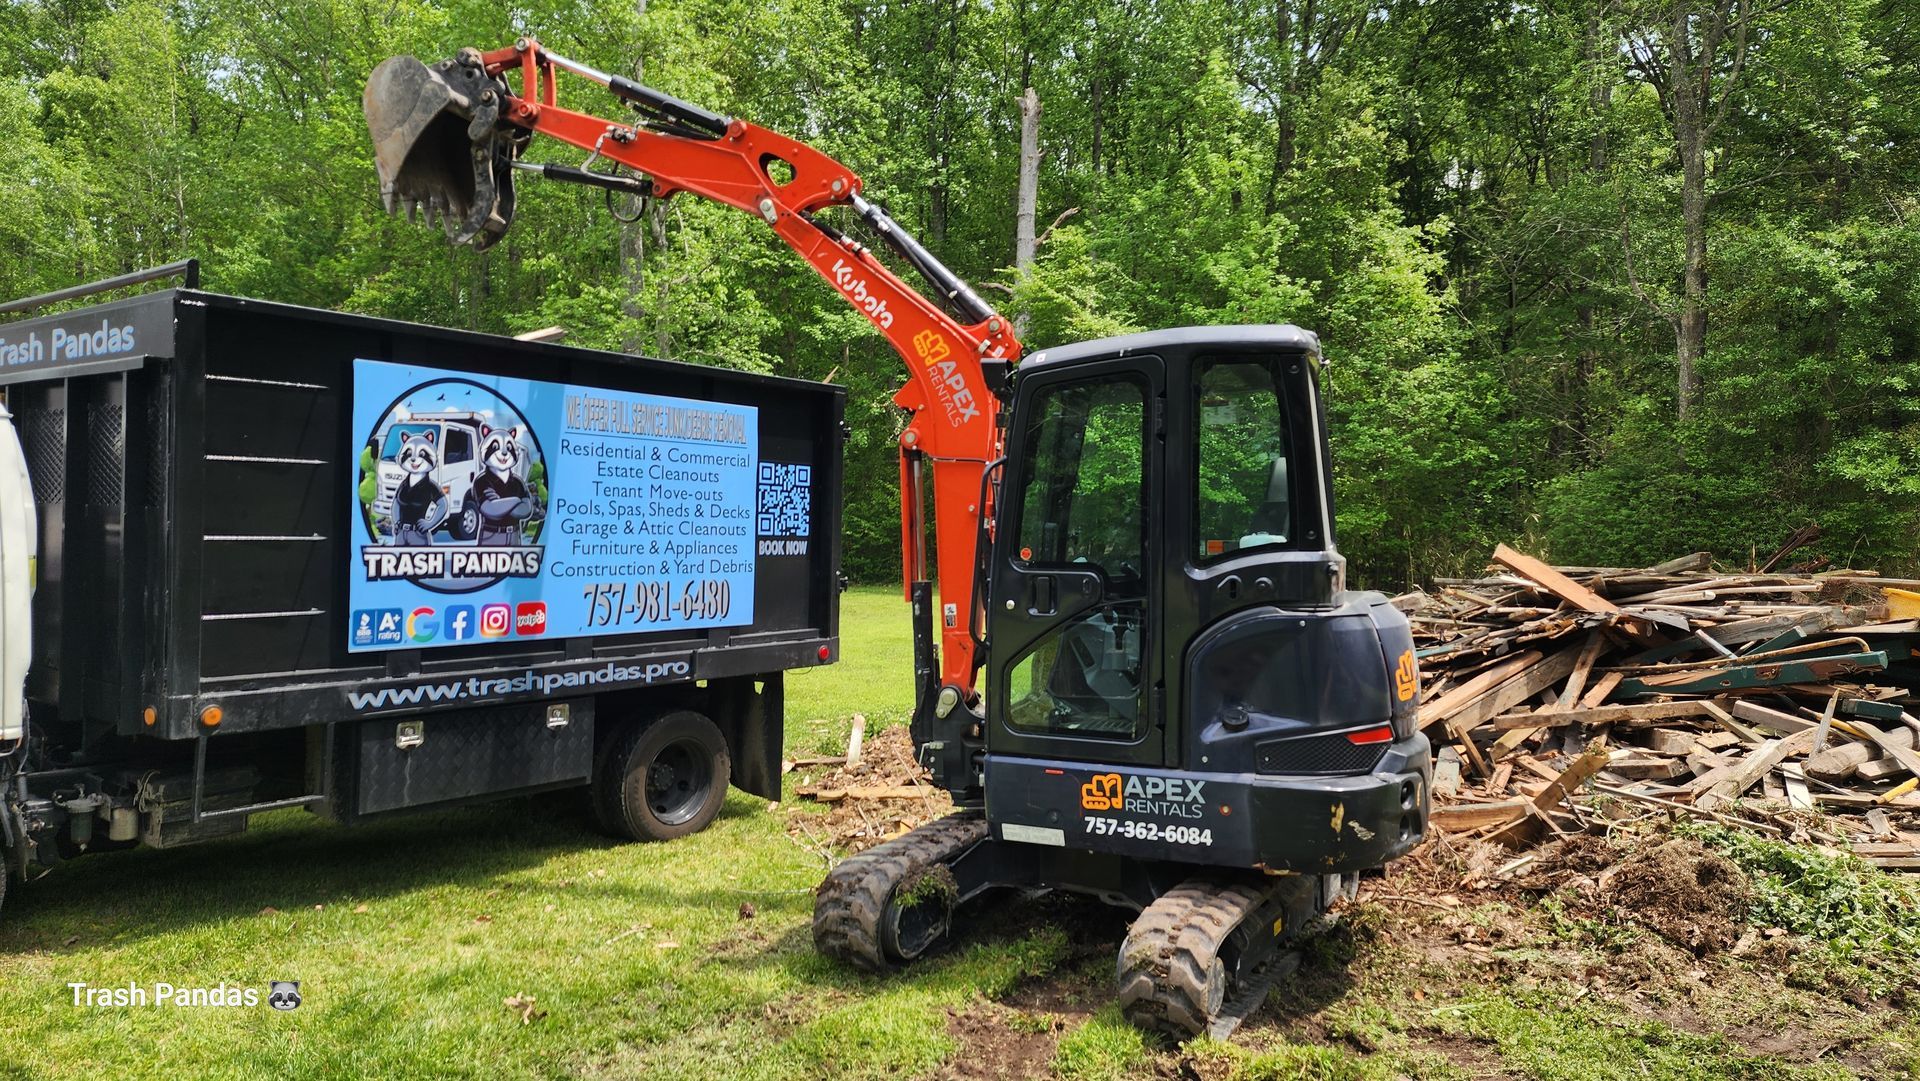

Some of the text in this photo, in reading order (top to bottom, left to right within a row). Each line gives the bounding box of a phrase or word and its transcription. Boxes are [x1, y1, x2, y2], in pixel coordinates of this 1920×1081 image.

[831, 258, 894, 330] Kubota
[0, 319, 135, 367] rash Pandas
[927, 365, 962, 429] RENTALS
[937, 360, 980, 424] APEX
[566, 395, 580, 430] WE
[583, 396, 609, 432] OFFER
[611, 399, 630, 434] FULL
[632, 402, 664, 437] SERVICE
[714, 411, 747, 444] REMOVAL
[561, 439, 750, 468] Residential & Commercial
[597, 461, 720, 483] Estate Cleanouts
[592, 481, 723, 501] Tenant Move-outs
[556, 499, 750, 520] Pools, Spas, Sheds & Decks
[561, 518, 747, 539] Garage & Attic Cleanouts
[572, 540, 738, 558] Furniture & Appliances
[758, 541, 808, 556] BOOK NOW
[363, 551, 540, 579] TRASH PANDAS
[550, 559, 753, 577] Construction & Yard Debris
[584, 579, 730, 627] 757-981-6480
[378, 612, 401, 631] A+
[377, 631, 401, 641] rating
[348, 659, 690, 710] www.trashpandas.pro
[1124, 775, 1206, 804] APEX
[1125, 798, 1202, 818] RENTALS
[1084, 816, 1213, 847] 757-362-6084
